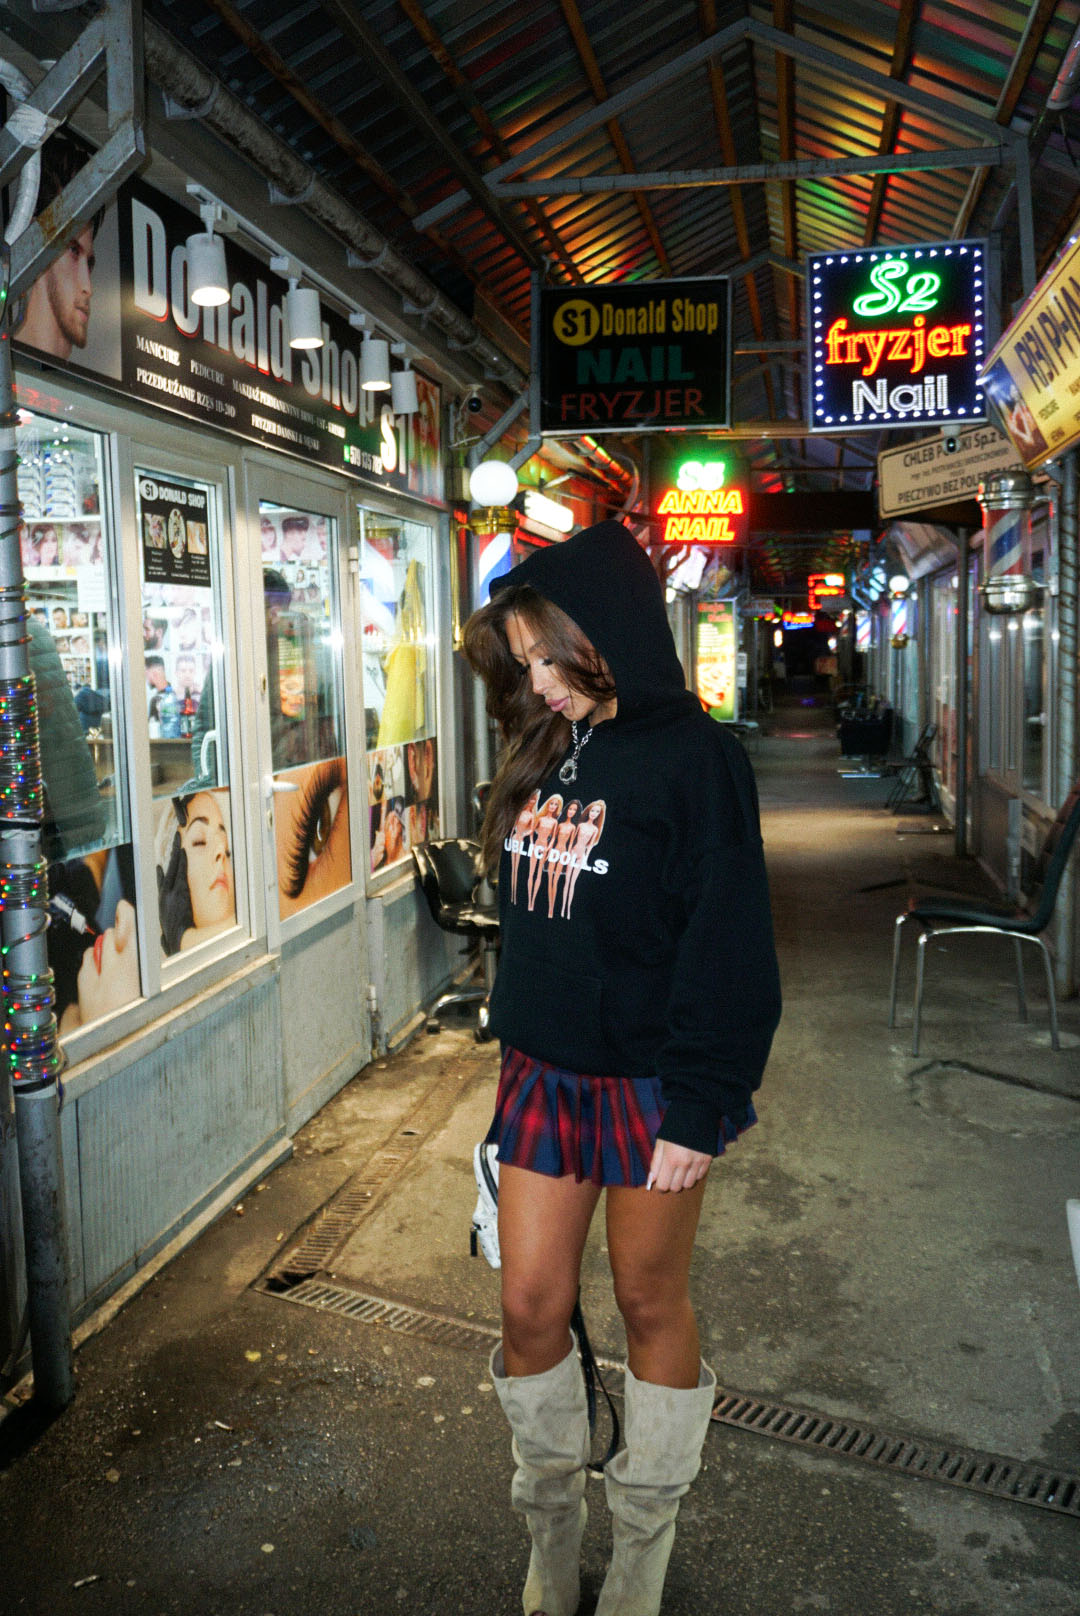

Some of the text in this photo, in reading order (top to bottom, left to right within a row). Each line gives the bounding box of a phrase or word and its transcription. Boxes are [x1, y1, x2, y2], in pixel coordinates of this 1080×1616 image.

[853, 260, 941, 316] S2
[561, 298, 718, 338] S1 Donald Shop
[136, 335, 180, 366] MANICURE
[190, 359, 224, 386] PEDICURE
[825, 314, 972, 376] fryzjer
[577, 345, 695, 384] NAIL
[561, 388, 704, 421] FRYZJER
[852, 375, 948, 415] Nail
[903, 447, 934, 468] CHLEB
[145, 484, 206, 509] S1 DONALD SHOP
[657, 490, 743, 514] ANNA
[898, 479, 958, 504] PIECZYWO BEZ
[664, 517, 735, 541] NAIL
[504, 838, 609, 875] UBLIC DOLLS
